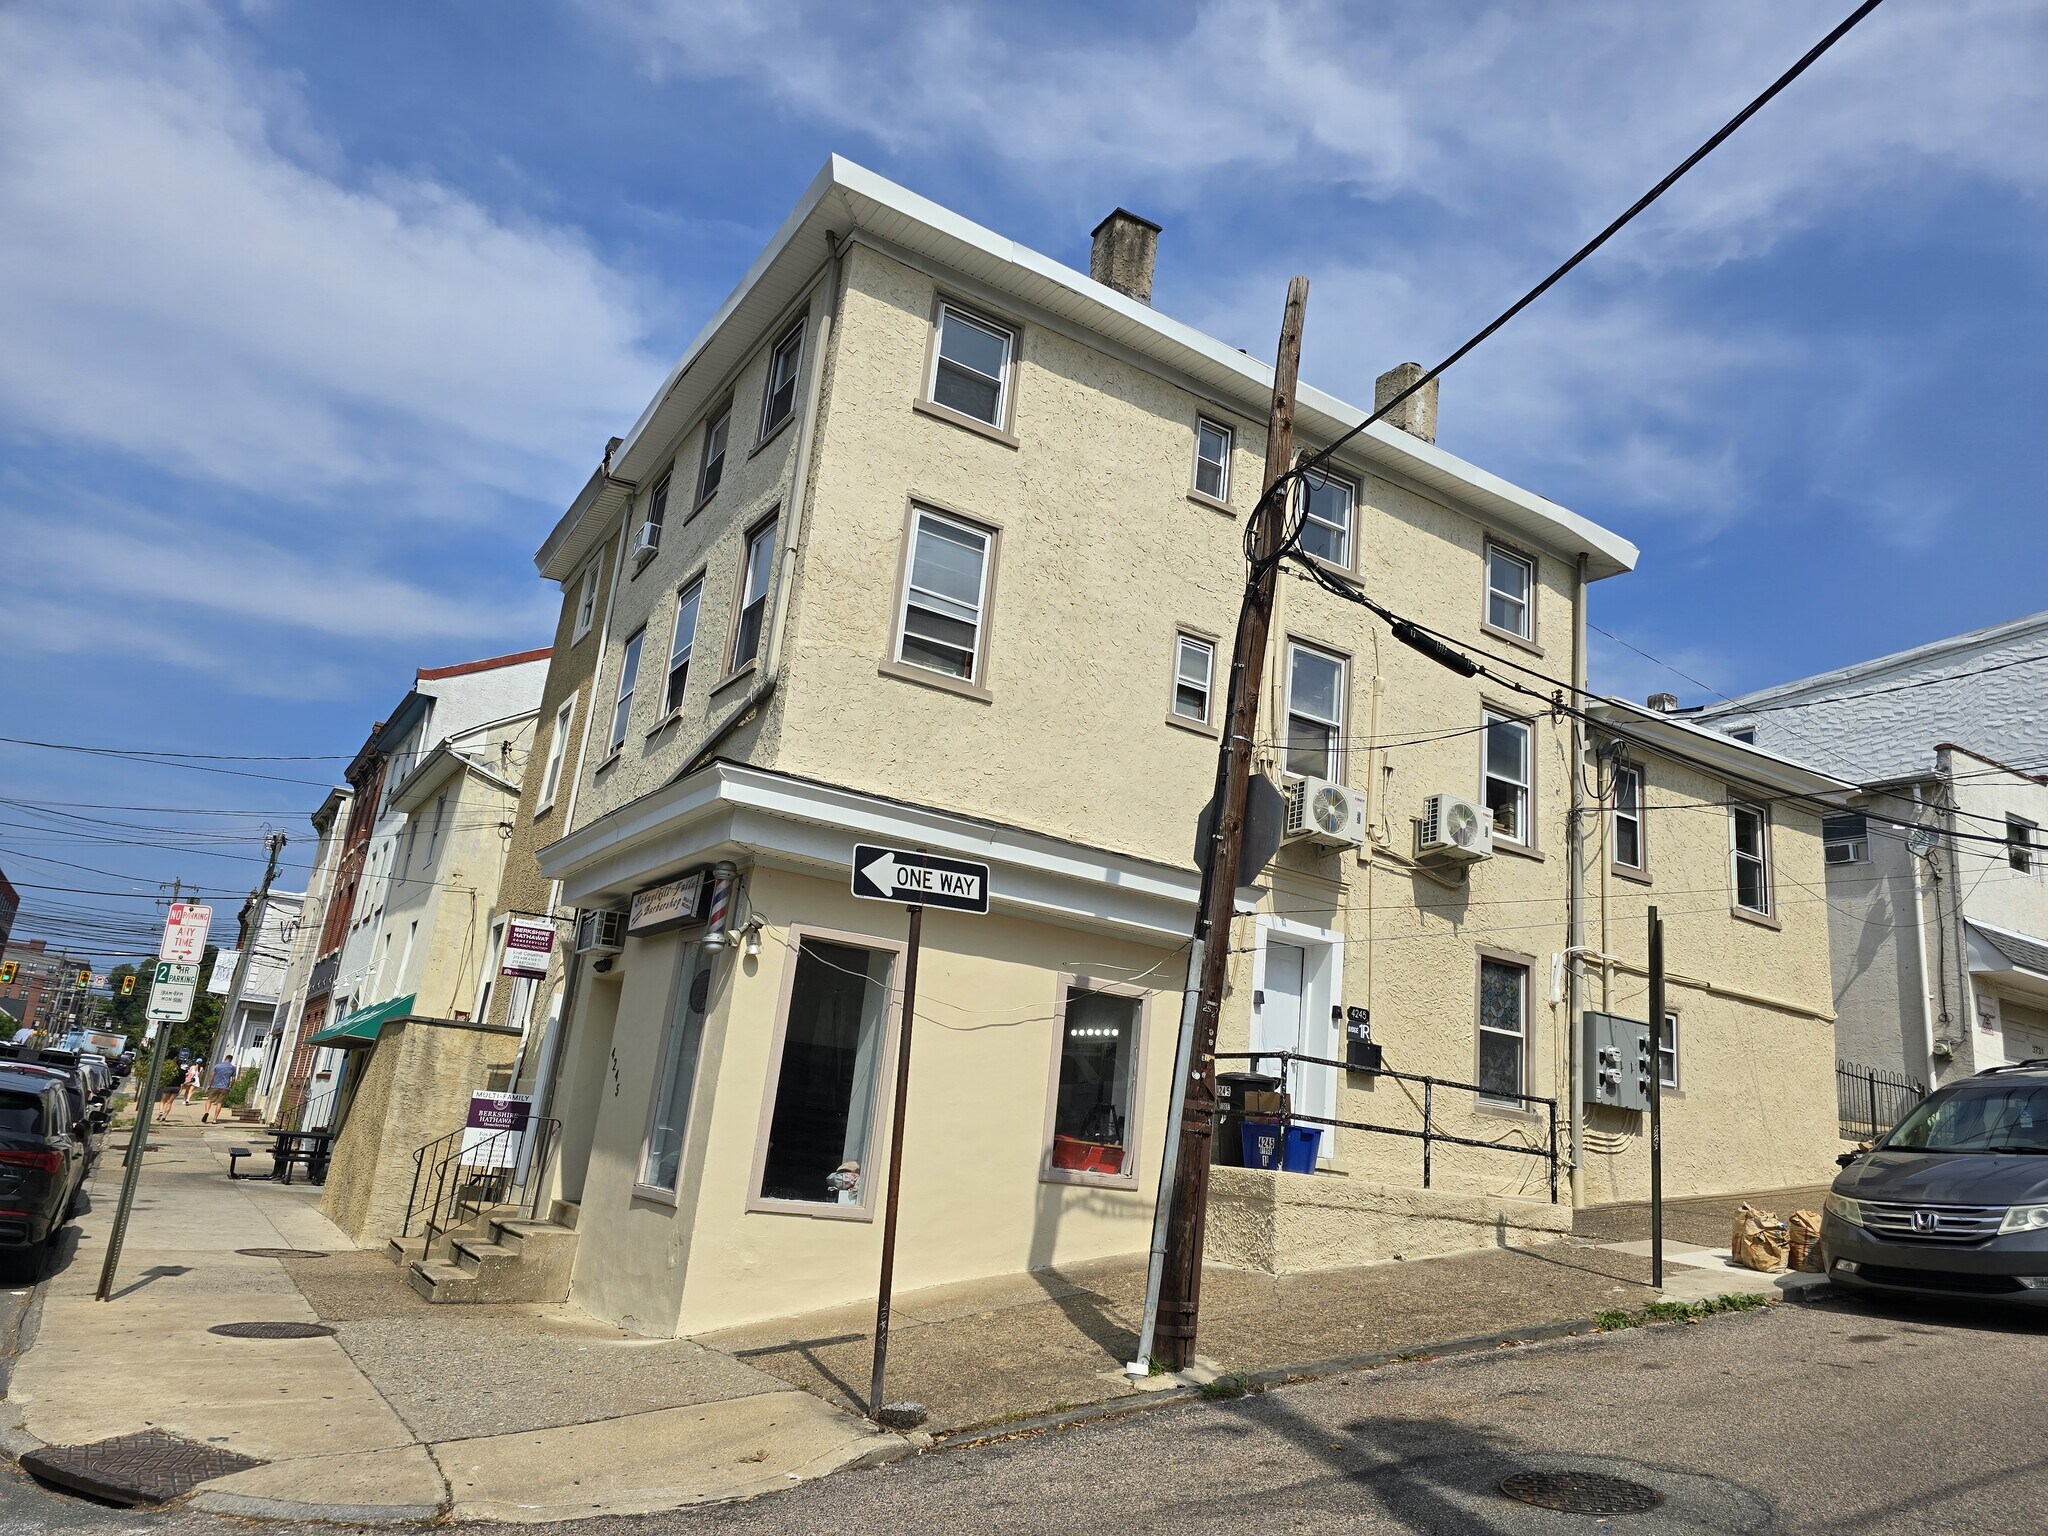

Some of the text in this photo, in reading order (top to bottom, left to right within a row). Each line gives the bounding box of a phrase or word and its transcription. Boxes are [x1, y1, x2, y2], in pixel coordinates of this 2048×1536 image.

[897, 867, 975, 896] ONE WAY
[643, 897, 681, 917] Barbershop
[170, 909, 208, 921] NO PARKING
[513, 933, 549, 942] HATHAWAY
[514, 927, 551, 937] BERKSHIRE
[174, 937, 194, 947] TIME
[158, 966, 190, 980] 2 HR
[168, 975, 195, 984] PARKING
[1351, 1009, 1367, 1020] 4245
[1359, 1024, 1370, 1040] 1R
[475, 1091, 530, 1102] MULTI-FAMILY
[478, 1110, 519, 1119] BERKSHIRE
[479, 1116, 516, 1125] HATHAWAY
[1258, 1136, 1275, 1149] 4245
